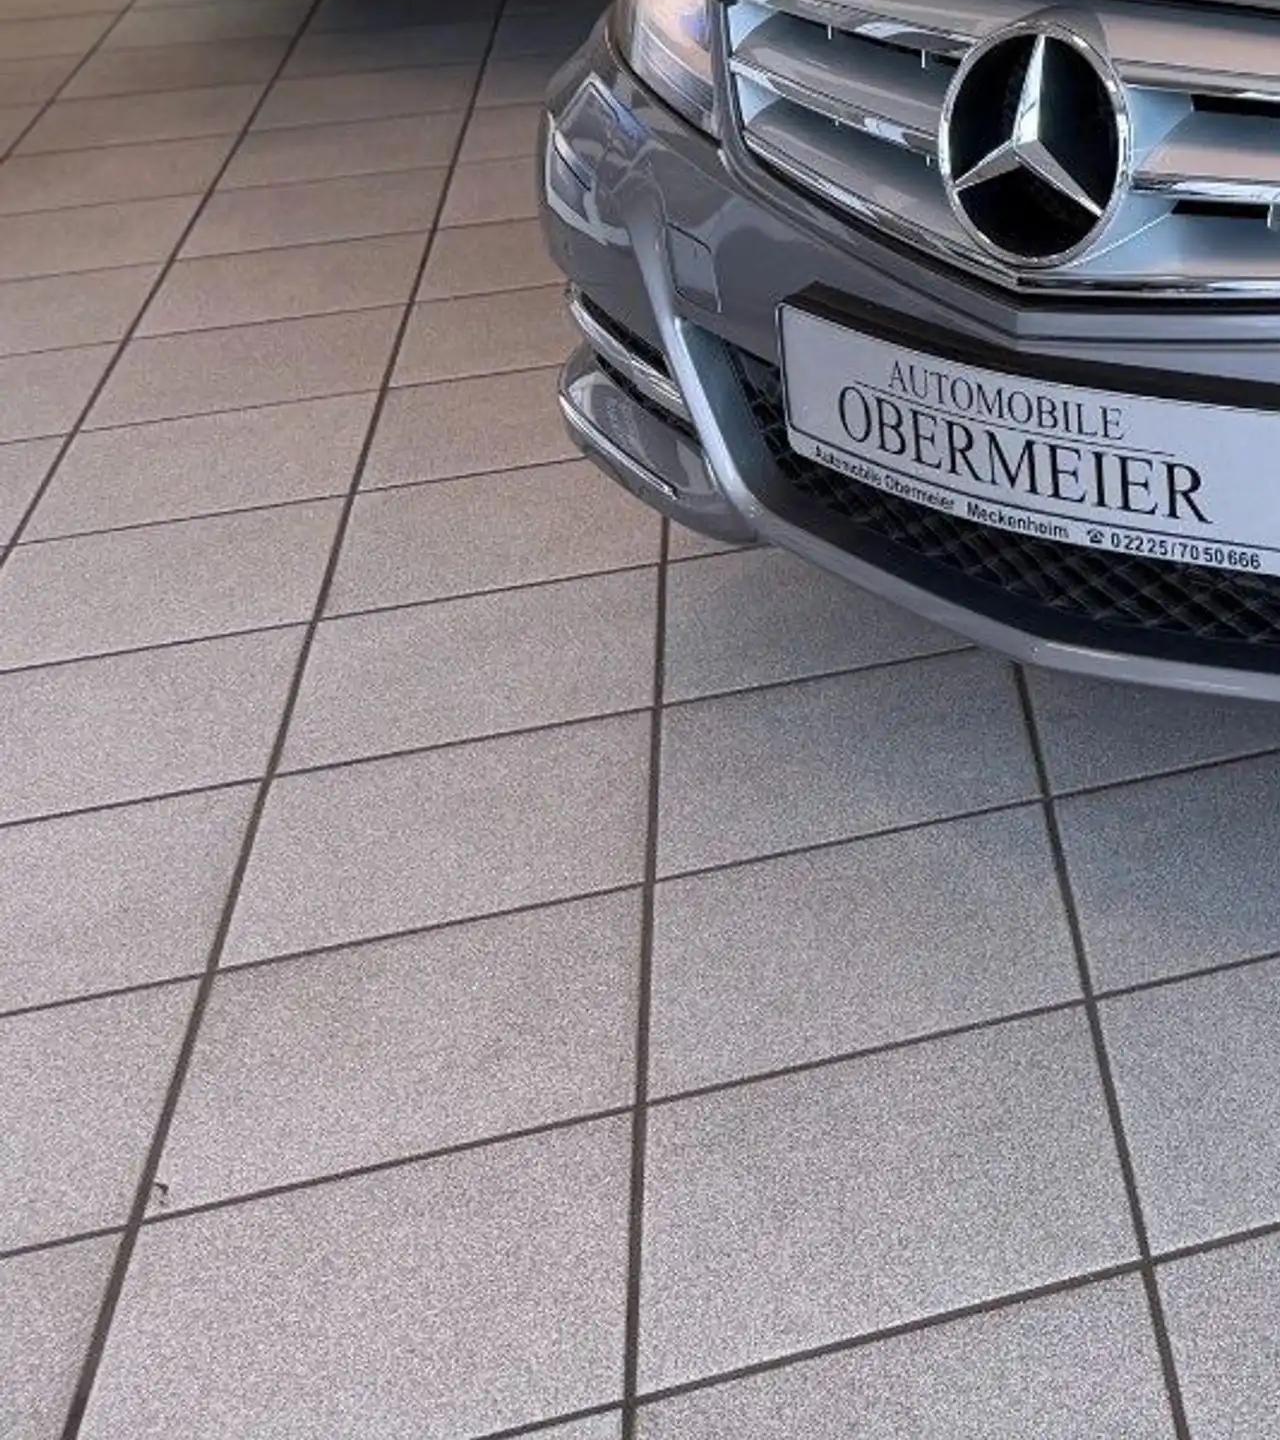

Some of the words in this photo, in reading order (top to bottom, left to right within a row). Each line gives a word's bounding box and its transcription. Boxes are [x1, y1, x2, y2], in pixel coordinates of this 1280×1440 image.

[889, 359, 1127, 442] AUTOMOBILE
[838, 385, 1214, 525] OBERMEIER
[883, 474, 956, 510] Obermeier
[966, 501, 1071, 540] Meckenheim
